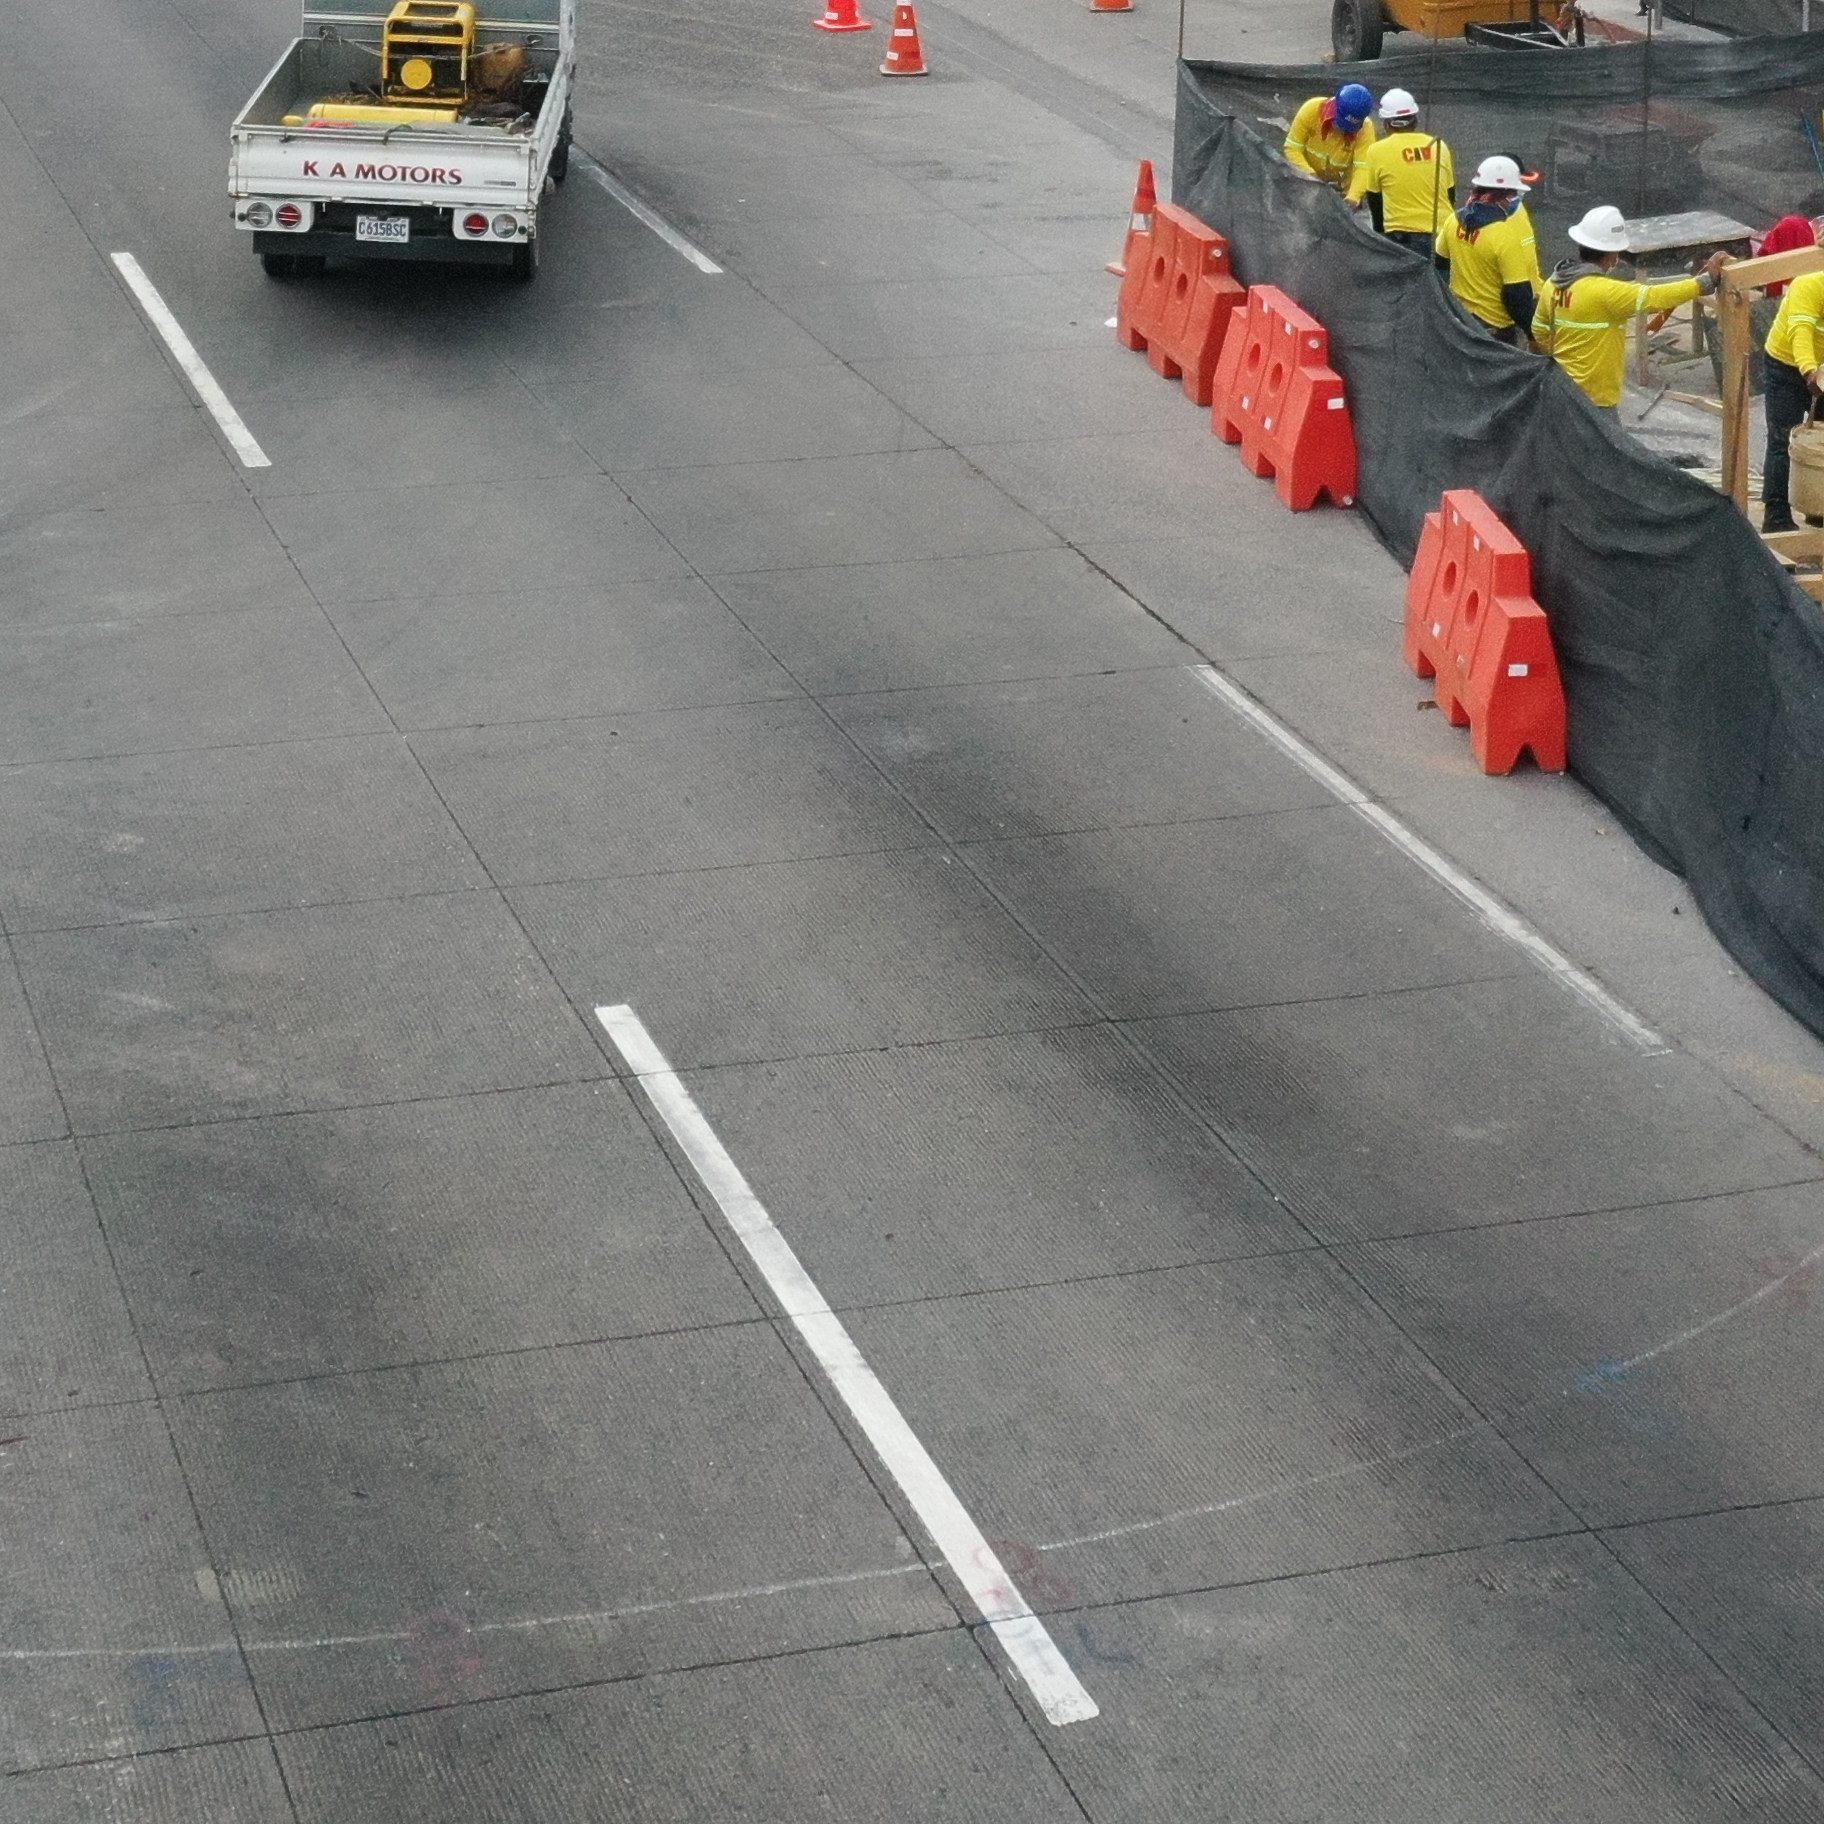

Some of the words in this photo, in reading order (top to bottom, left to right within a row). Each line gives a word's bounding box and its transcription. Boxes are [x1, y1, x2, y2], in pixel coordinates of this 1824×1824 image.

[303, 160, 320, 178] K
[329, 162, 347, 179] A
[354, 163, 463, 186] MOTORS
